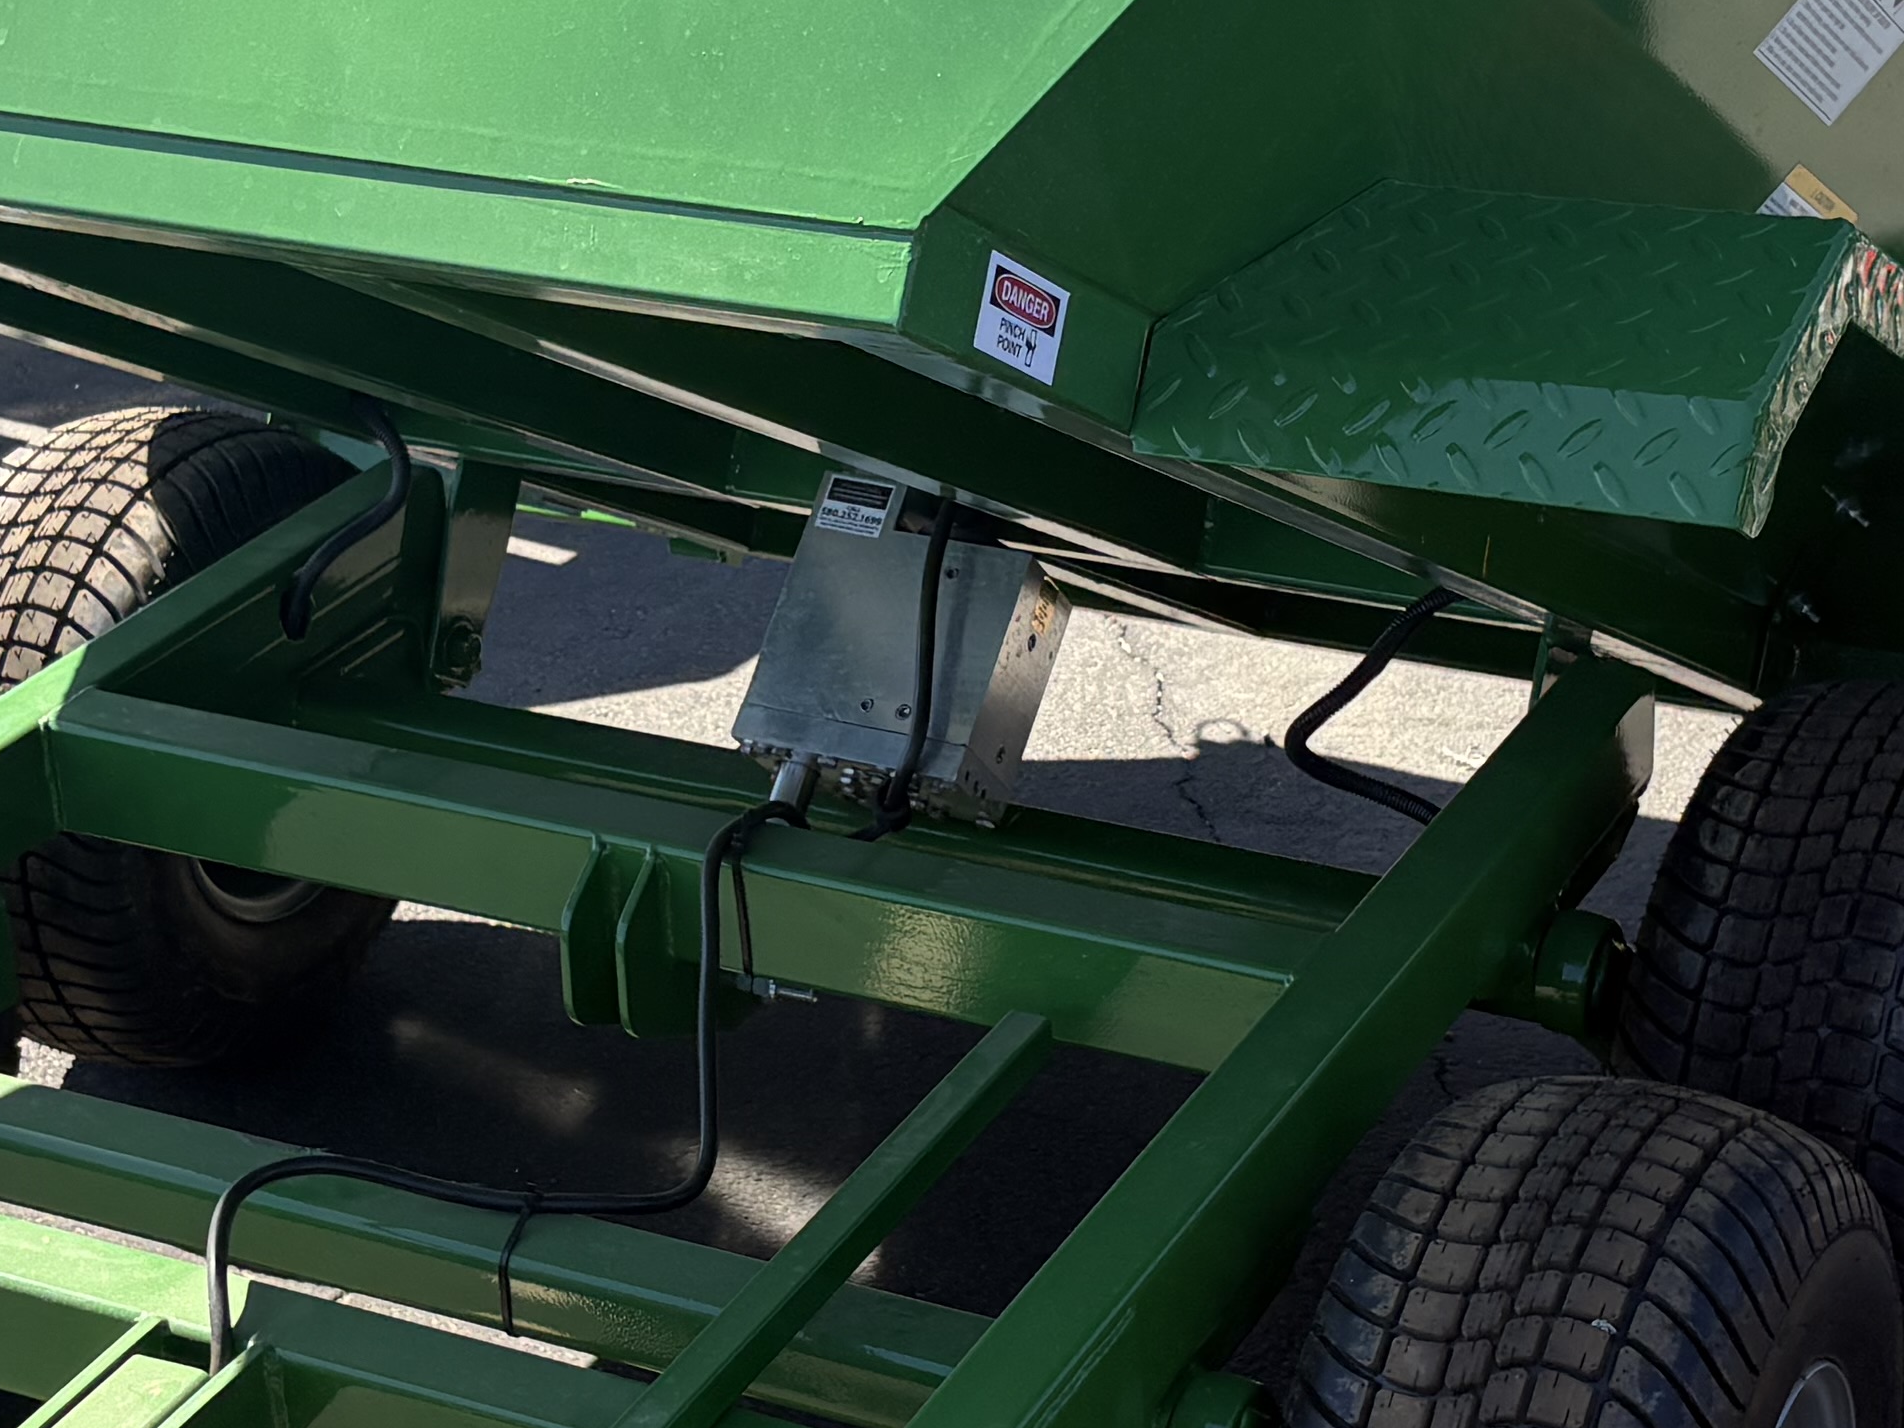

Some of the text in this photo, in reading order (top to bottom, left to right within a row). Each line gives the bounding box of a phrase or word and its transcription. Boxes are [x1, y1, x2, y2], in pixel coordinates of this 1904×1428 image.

[1001, 280, 1050, 323] DANGER
[999, 317, 1027, 341] PINCH
[997, 335, 1023, 358] POINT
